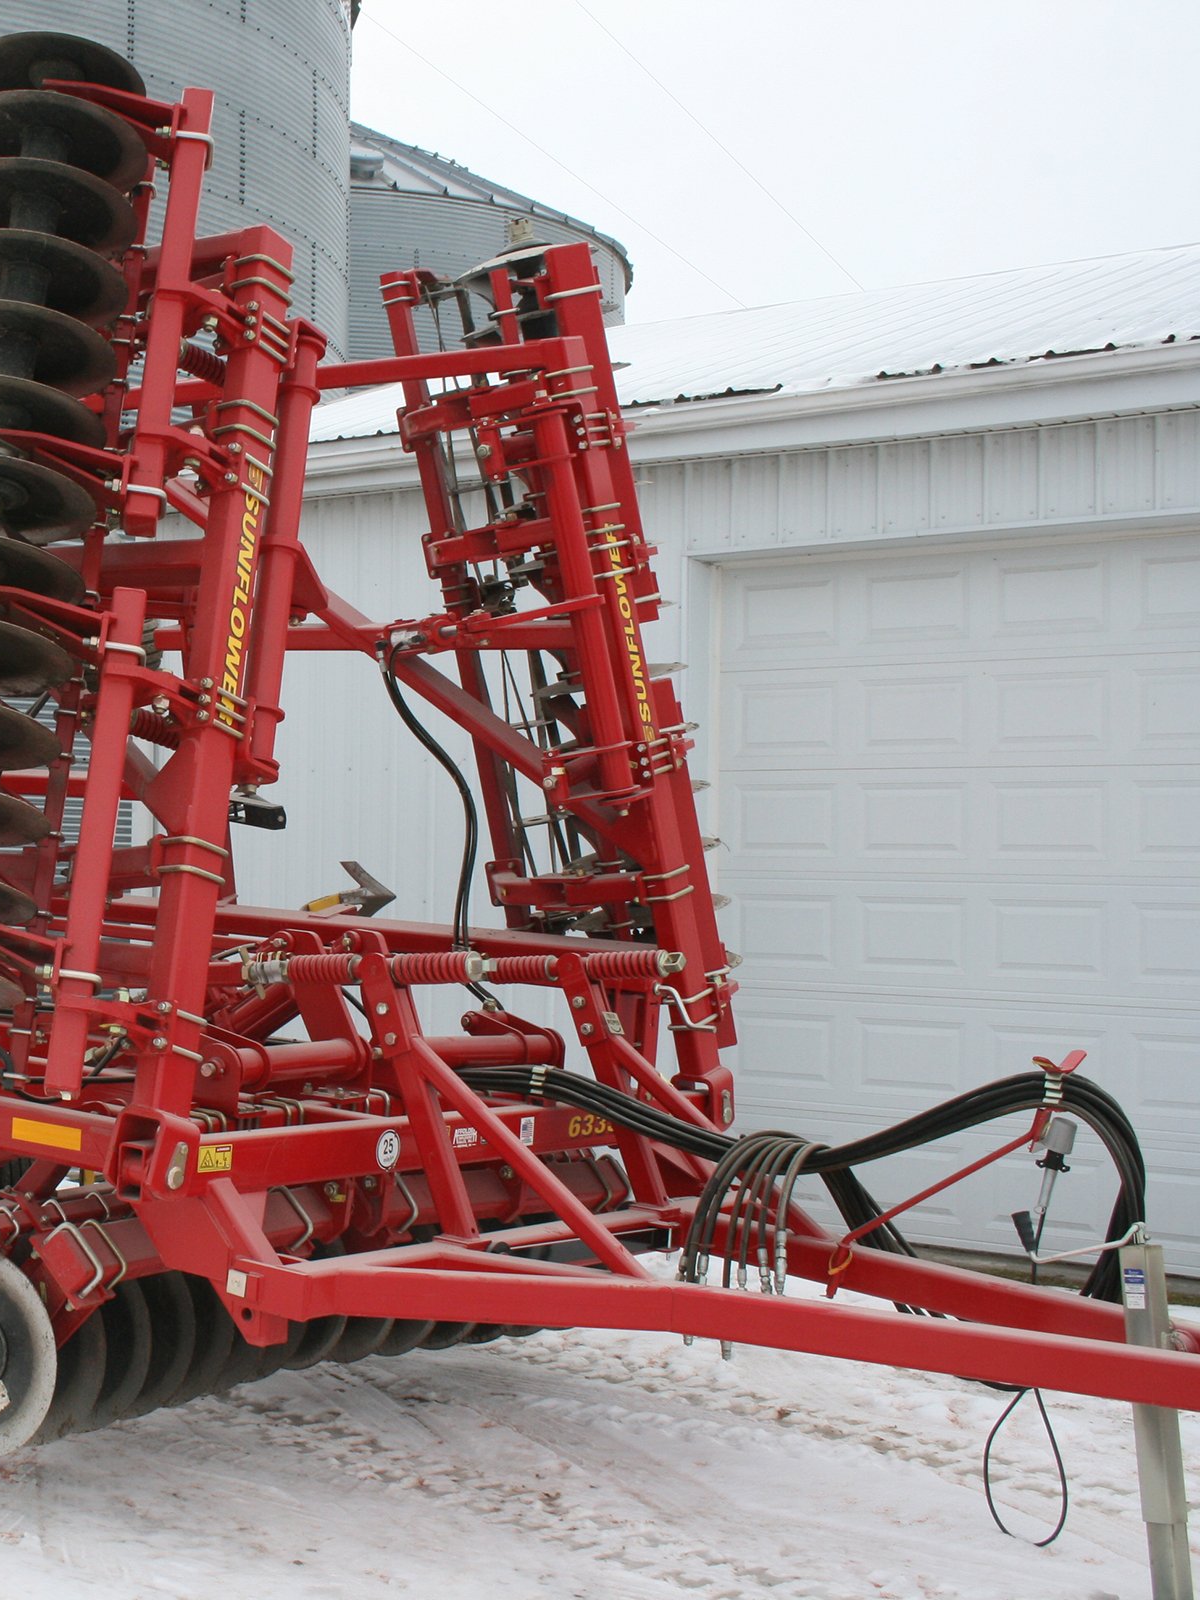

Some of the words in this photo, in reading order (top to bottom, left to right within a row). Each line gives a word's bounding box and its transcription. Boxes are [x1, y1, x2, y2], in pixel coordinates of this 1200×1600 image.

[219, 492, 260, 726] SUNFLOWER
[604, 522, 652, 723] SUNFLOWER
[383, 1138, 394, 1155] 25
[568, 1113, 615, 1138] 633
